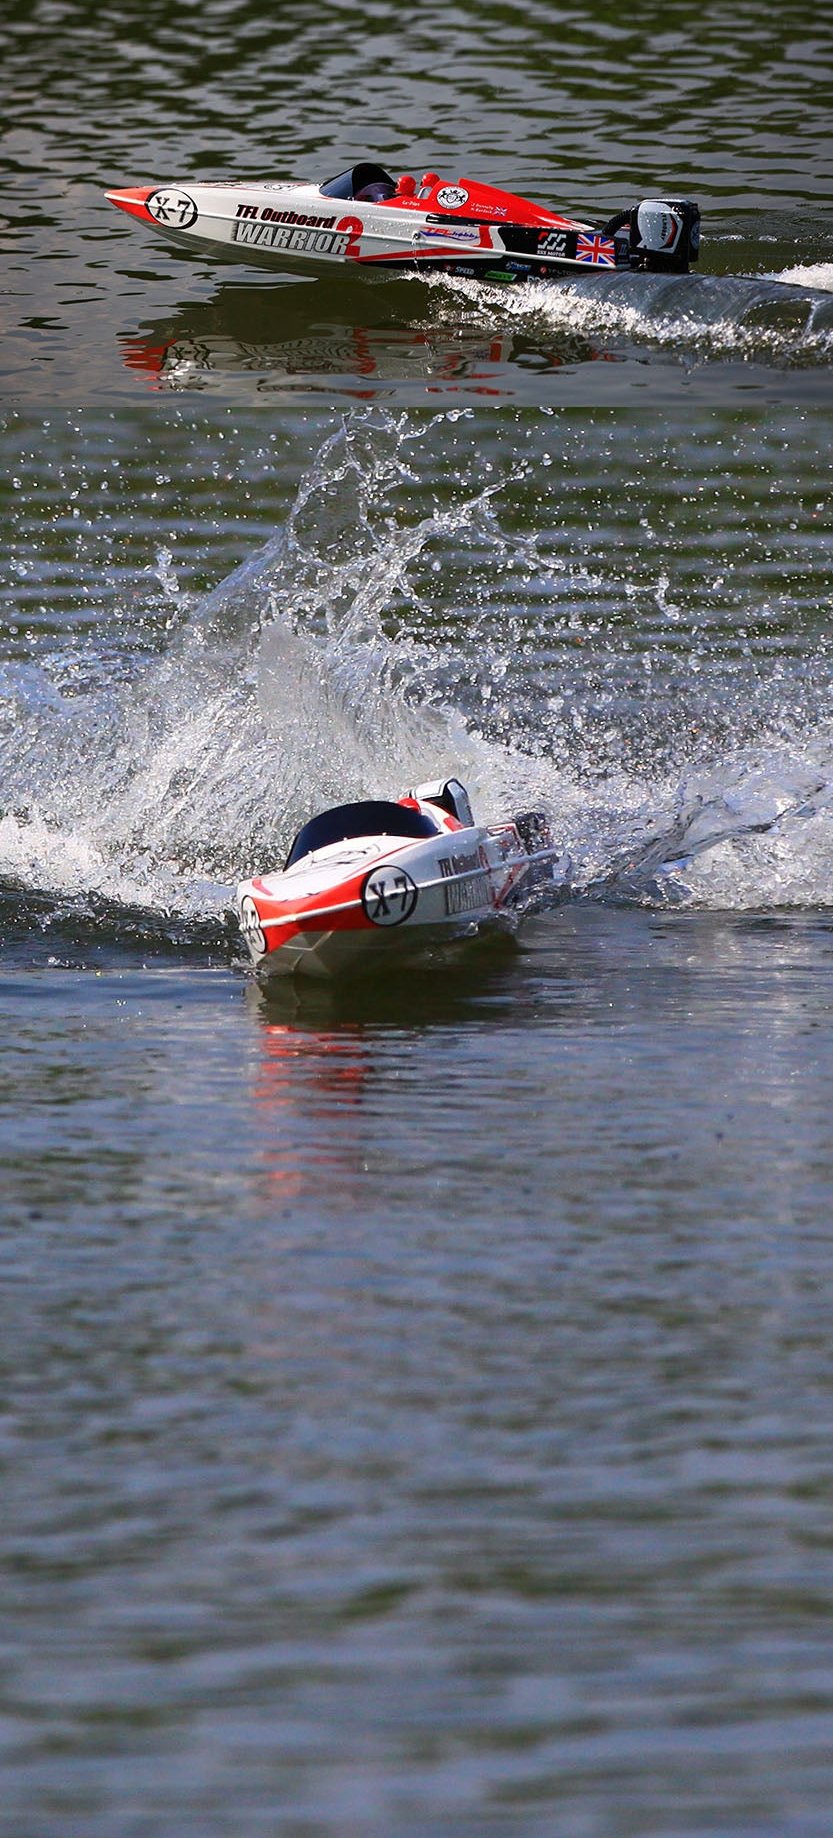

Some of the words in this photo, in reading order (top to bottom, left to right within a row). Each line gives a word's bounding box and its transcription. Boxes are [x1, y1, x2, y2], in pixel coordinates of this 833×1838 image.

[155, 196, 192, 223] X-7
[235, 204, 259, 219] TFL
[260, 207, 337, 229] Outboard
[234, 222, 350, 255] WARRIOR
[336, 216, 364, 257] 2
[369, 875, 409, 919] X-7
